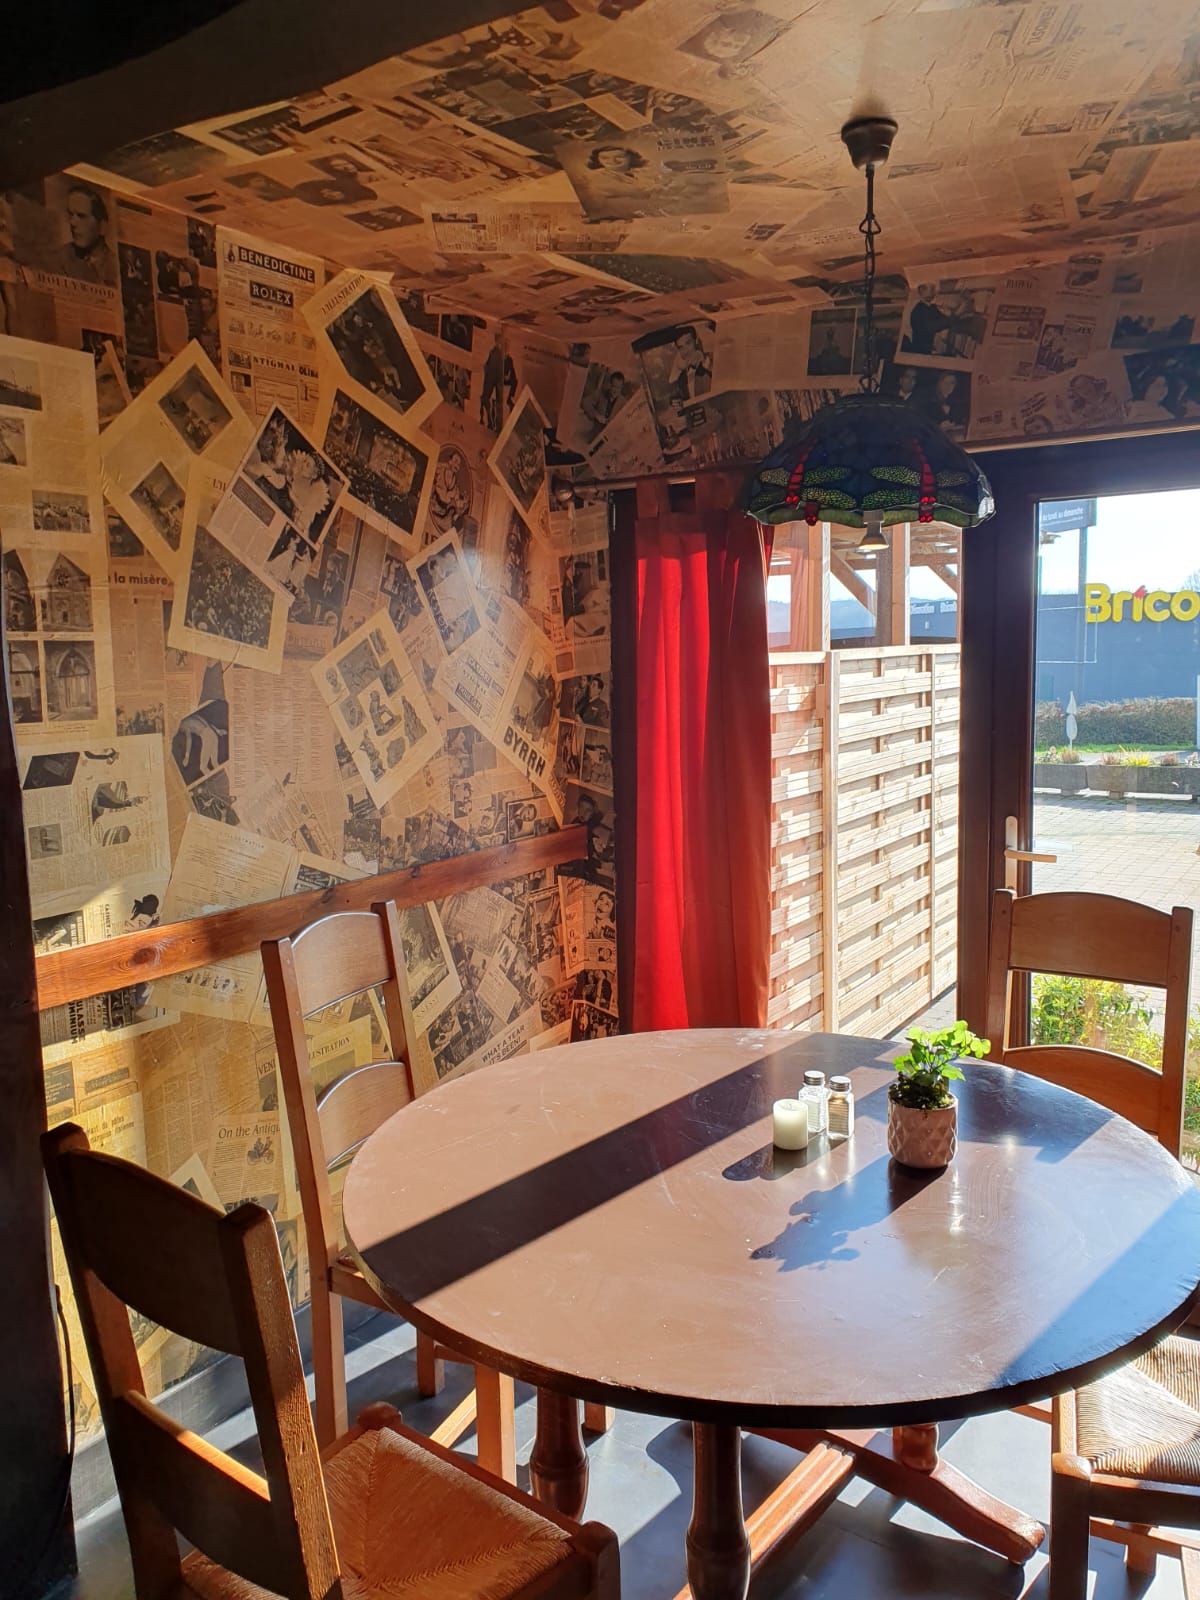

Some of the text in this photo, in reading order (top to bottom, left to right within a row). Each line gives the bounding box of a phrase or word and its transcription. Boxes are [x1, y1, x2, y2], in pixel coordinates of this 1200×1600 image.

[239, 247, 314, 283] BENEDICTINE
[252, 285, 292, 305] ROLEX
[113, 571, 125, 583] la
[1085, 582, 1200, 623] Brico
[503, 725, 547, 779] BYRRH
[218, 1127, 232, 1139] On
[235, 1126, 250, 1137] the
